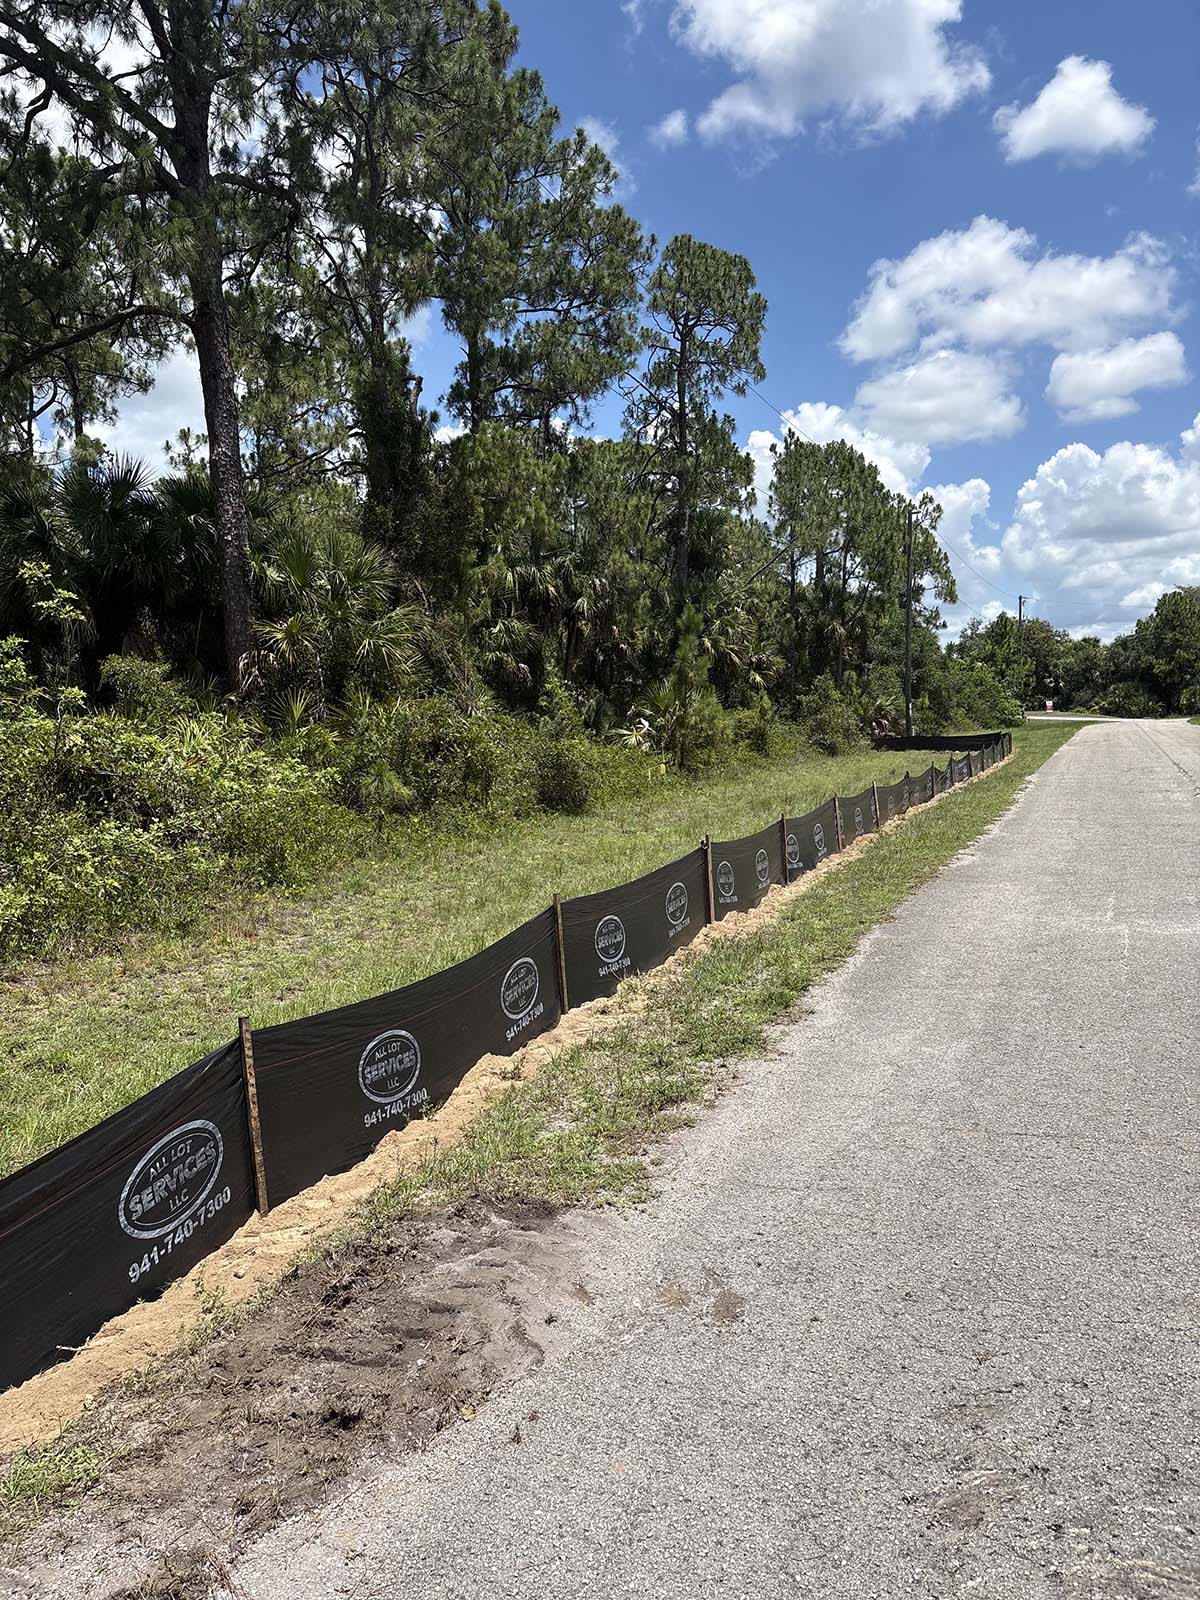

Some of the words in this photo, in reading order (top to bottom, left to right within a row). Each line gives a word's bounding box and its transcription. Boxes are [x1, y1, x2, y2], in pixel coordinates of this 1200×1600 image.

[597, 929, 623, 949] SERVICES
[504, 971, 536, 1007] SERVICES
[505, 1001, 544, 1042] 941-740-7300
[364, 1048, 416, 1085] SERVICES
[375, 1046, 387, 1061] ALL
[388, 1041, 401, 1053] LOT
[387, 1076, 400, 1089] LLC
[364, 1087, 428, 1128] 941-740-7300
[149, 1156, 169, 1182] ALL
[170, 1139, 194, 1162] LOT
[128, 1140, 217, 1221] SERVICES
[168, 1188, 190, 1212] LLC
[128, 1186, 231, 1283] 941-740-7300
